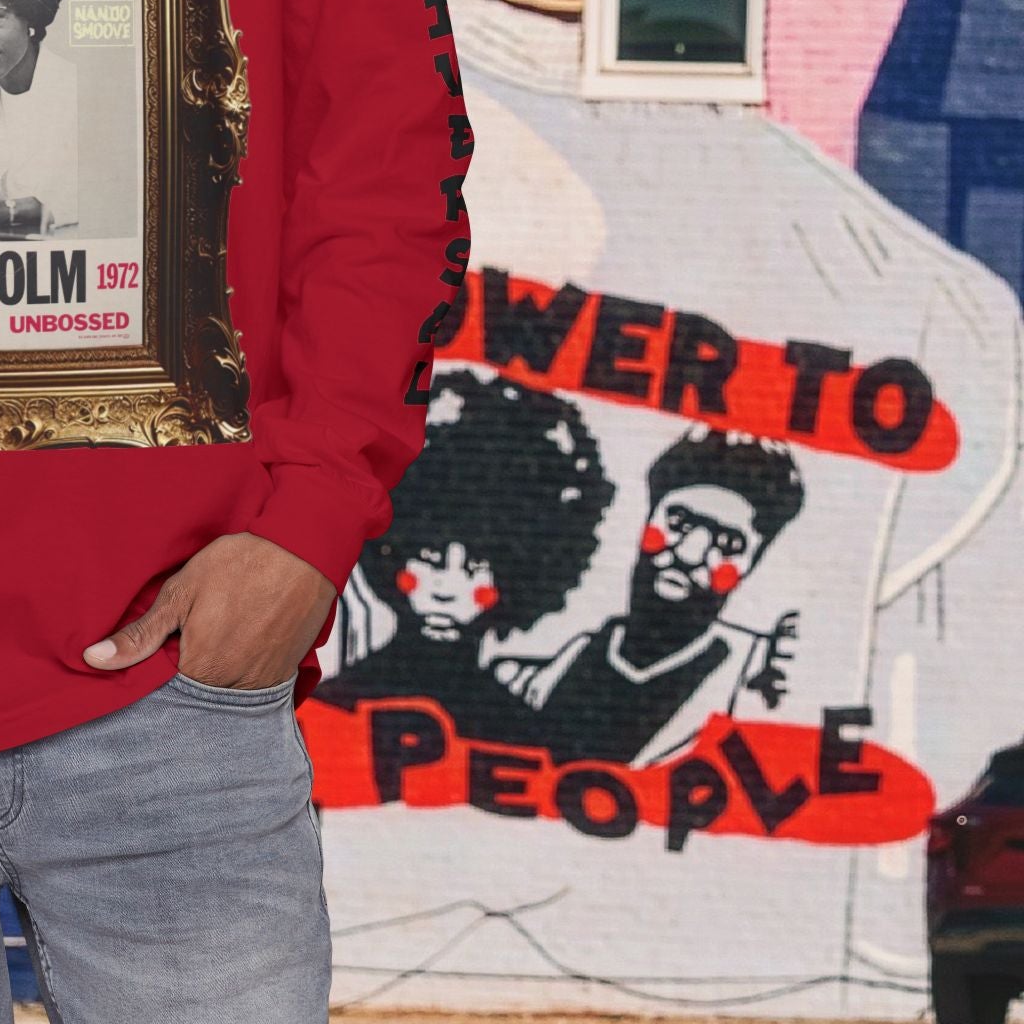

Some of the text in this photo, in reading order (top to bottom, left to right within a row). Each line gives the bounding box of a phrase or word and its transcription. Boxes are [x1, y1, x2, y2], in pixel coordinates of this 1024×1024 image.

[73, 22, 131, 39] SMOOVE
[96, 262, 140, 290] 1972
[10, 311, 130, 334] UNBOSSED
[784, 338, 934, 455] TO
[370, 706, 882, 853] PEOPLE
